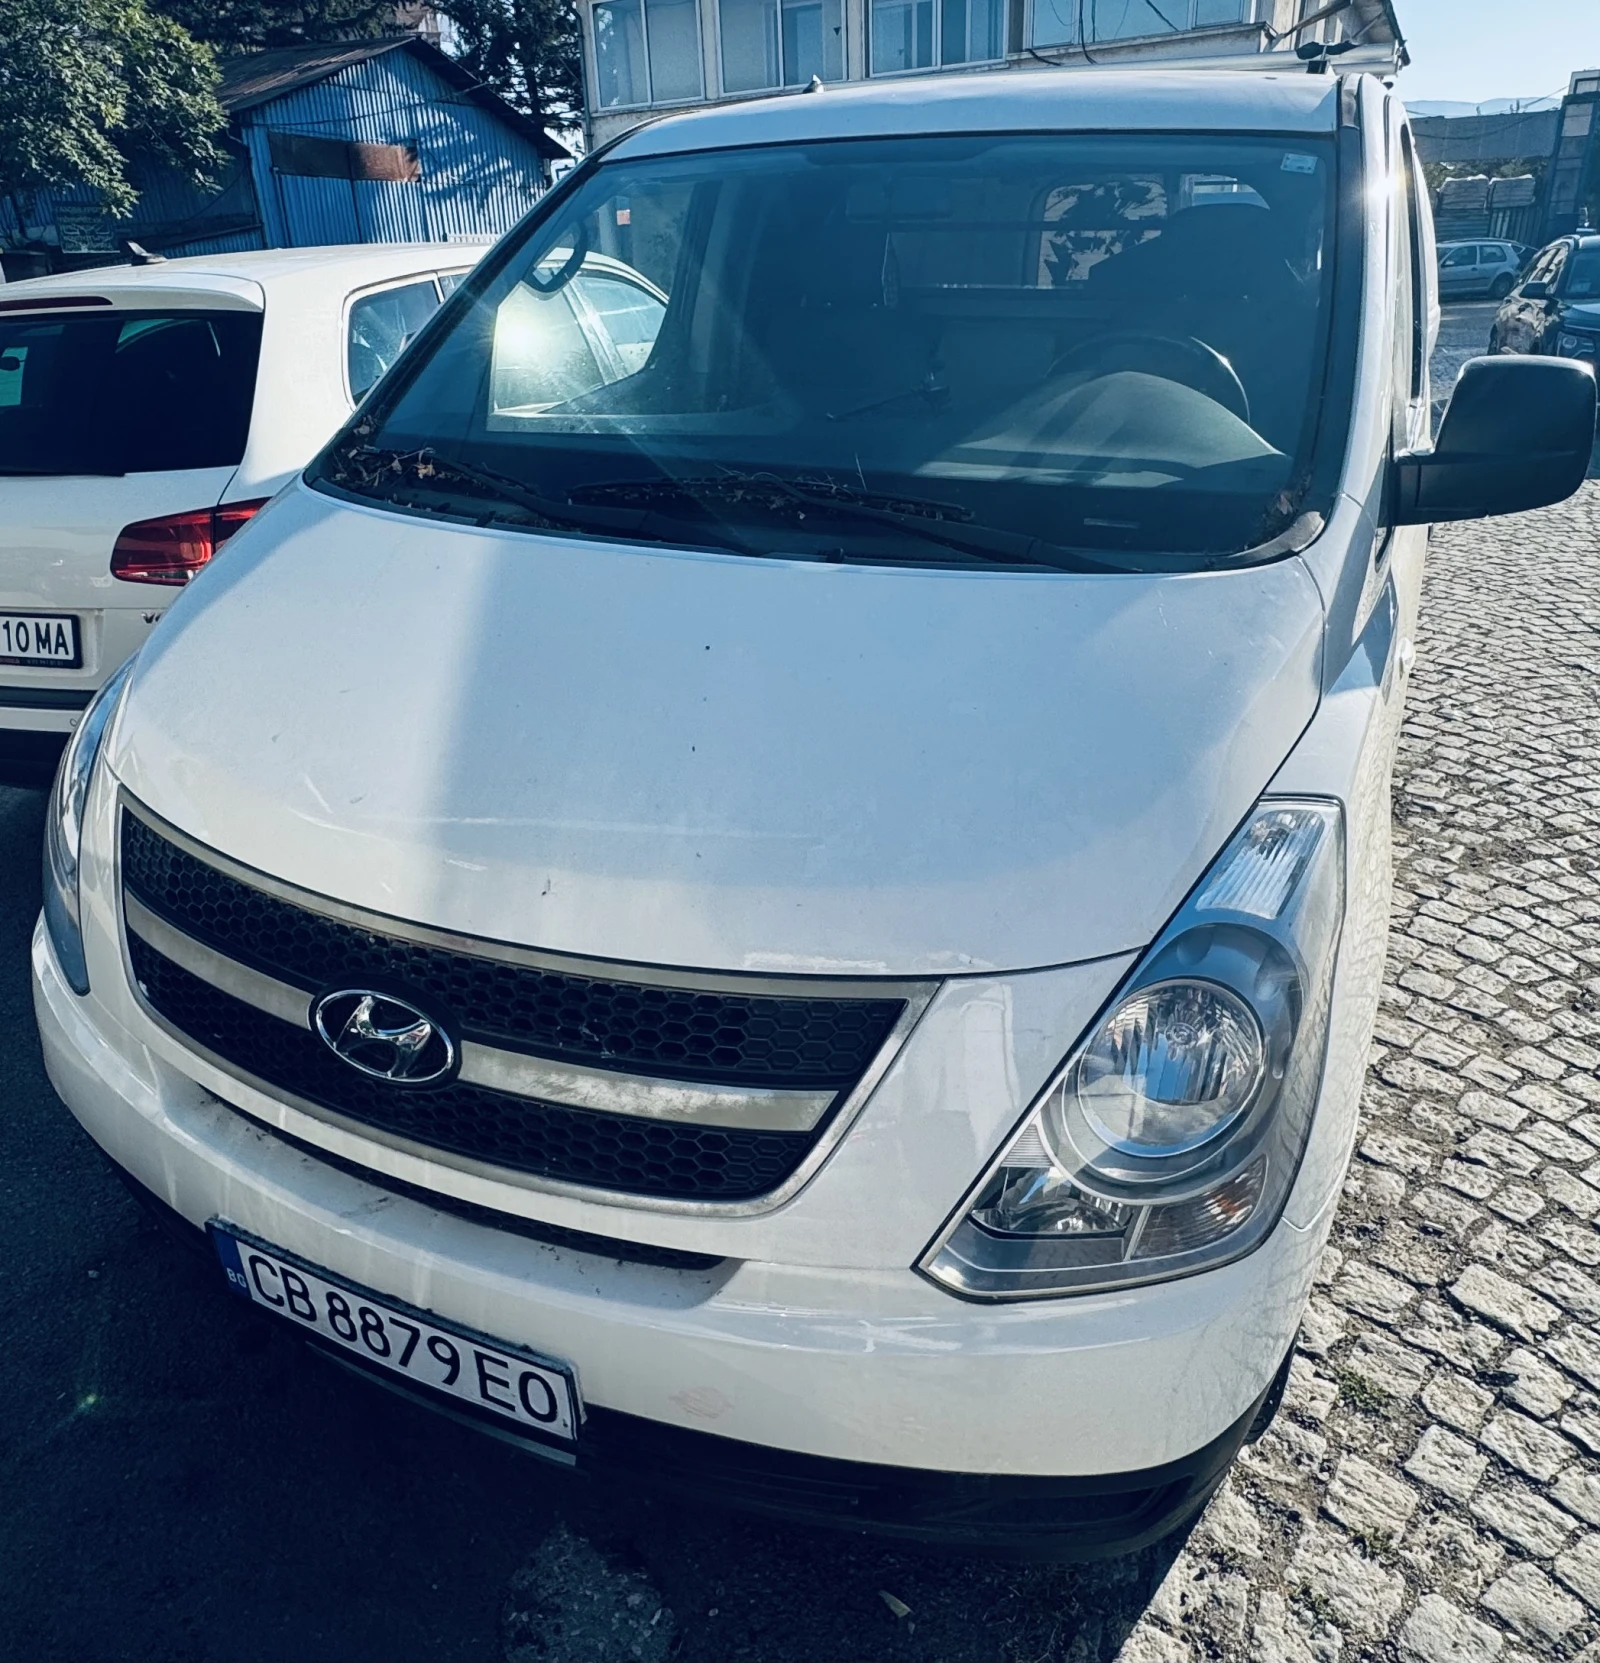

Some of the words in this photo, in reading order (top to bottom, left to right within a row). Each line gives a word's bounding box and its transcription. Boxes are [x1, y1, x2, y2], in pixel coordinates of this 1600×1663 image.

[34, 622, 69, 656] MA
[226, 1267, 247, 1288] BG
[248, 1254, 318, 1322] CB
[325, 1291, 461, 1386] 8879
[473, 1349, 558, 1423] EO
